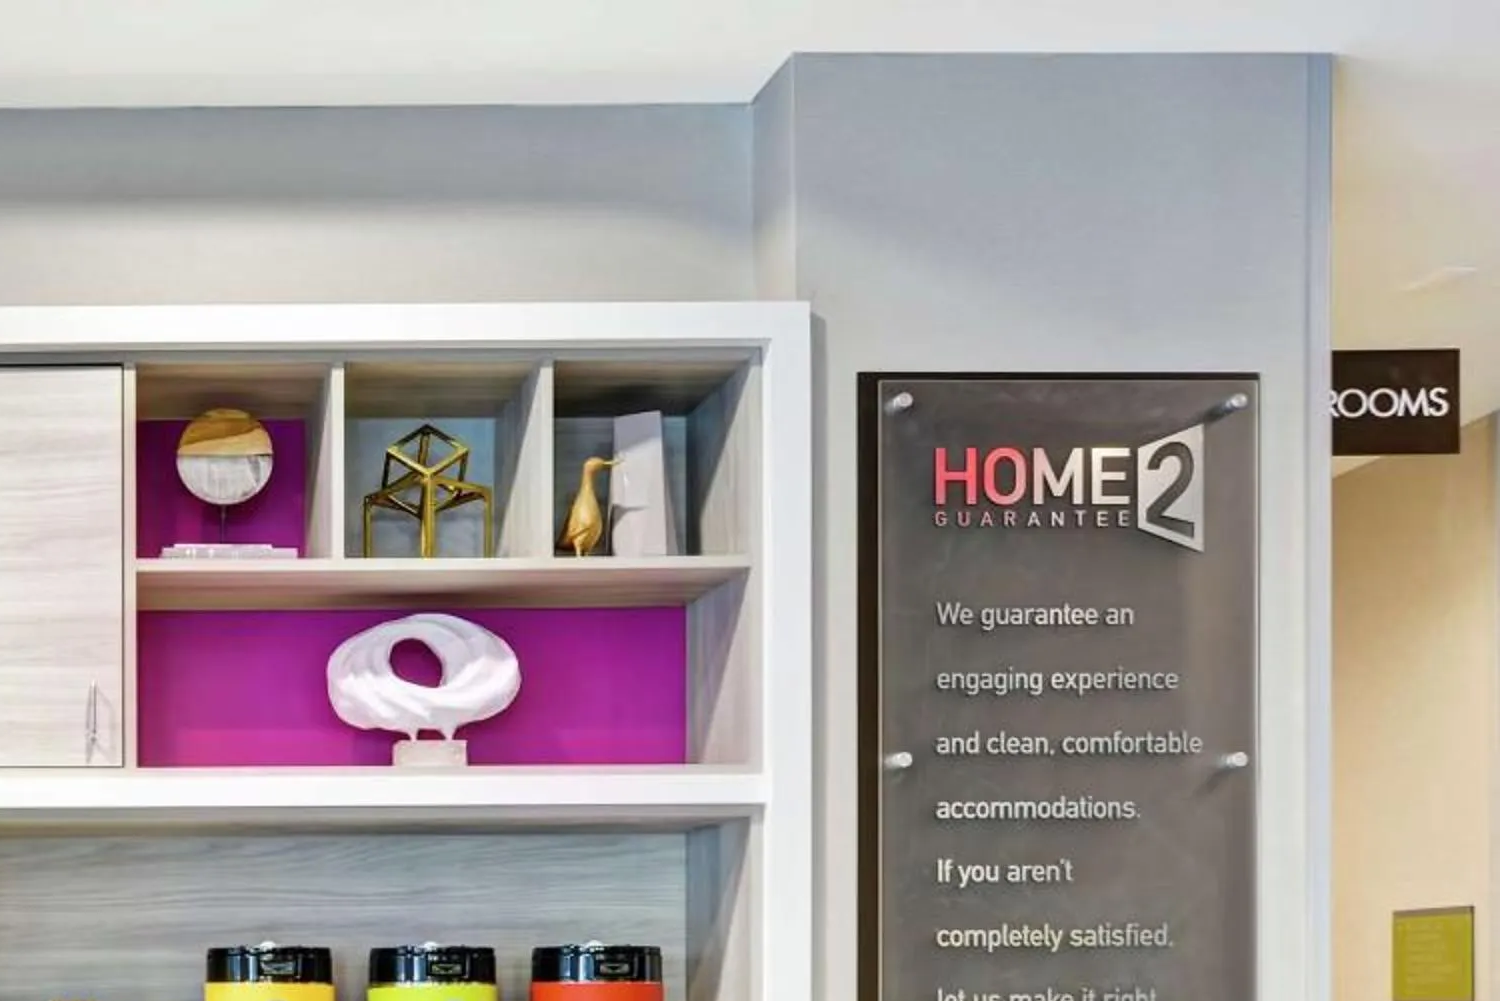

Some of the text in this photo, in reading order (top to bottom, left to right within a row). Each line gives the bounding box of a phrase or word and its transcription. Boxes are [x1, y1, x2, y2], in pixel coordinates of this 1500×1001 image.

[934, 509, 1131, 527] GUARANTEE
[936, 602, 1135, 631] We guarantee an
[937, 665, 1179, 696] engaging experience
[936, 730, 980, 755] and
[1061, 730, 1204, 755] comfortable
[935, 795, 1141, 819] accommodations.
[936, 857, 1075, 889] If you aren't
[936, 922, 1064, 953] completely
